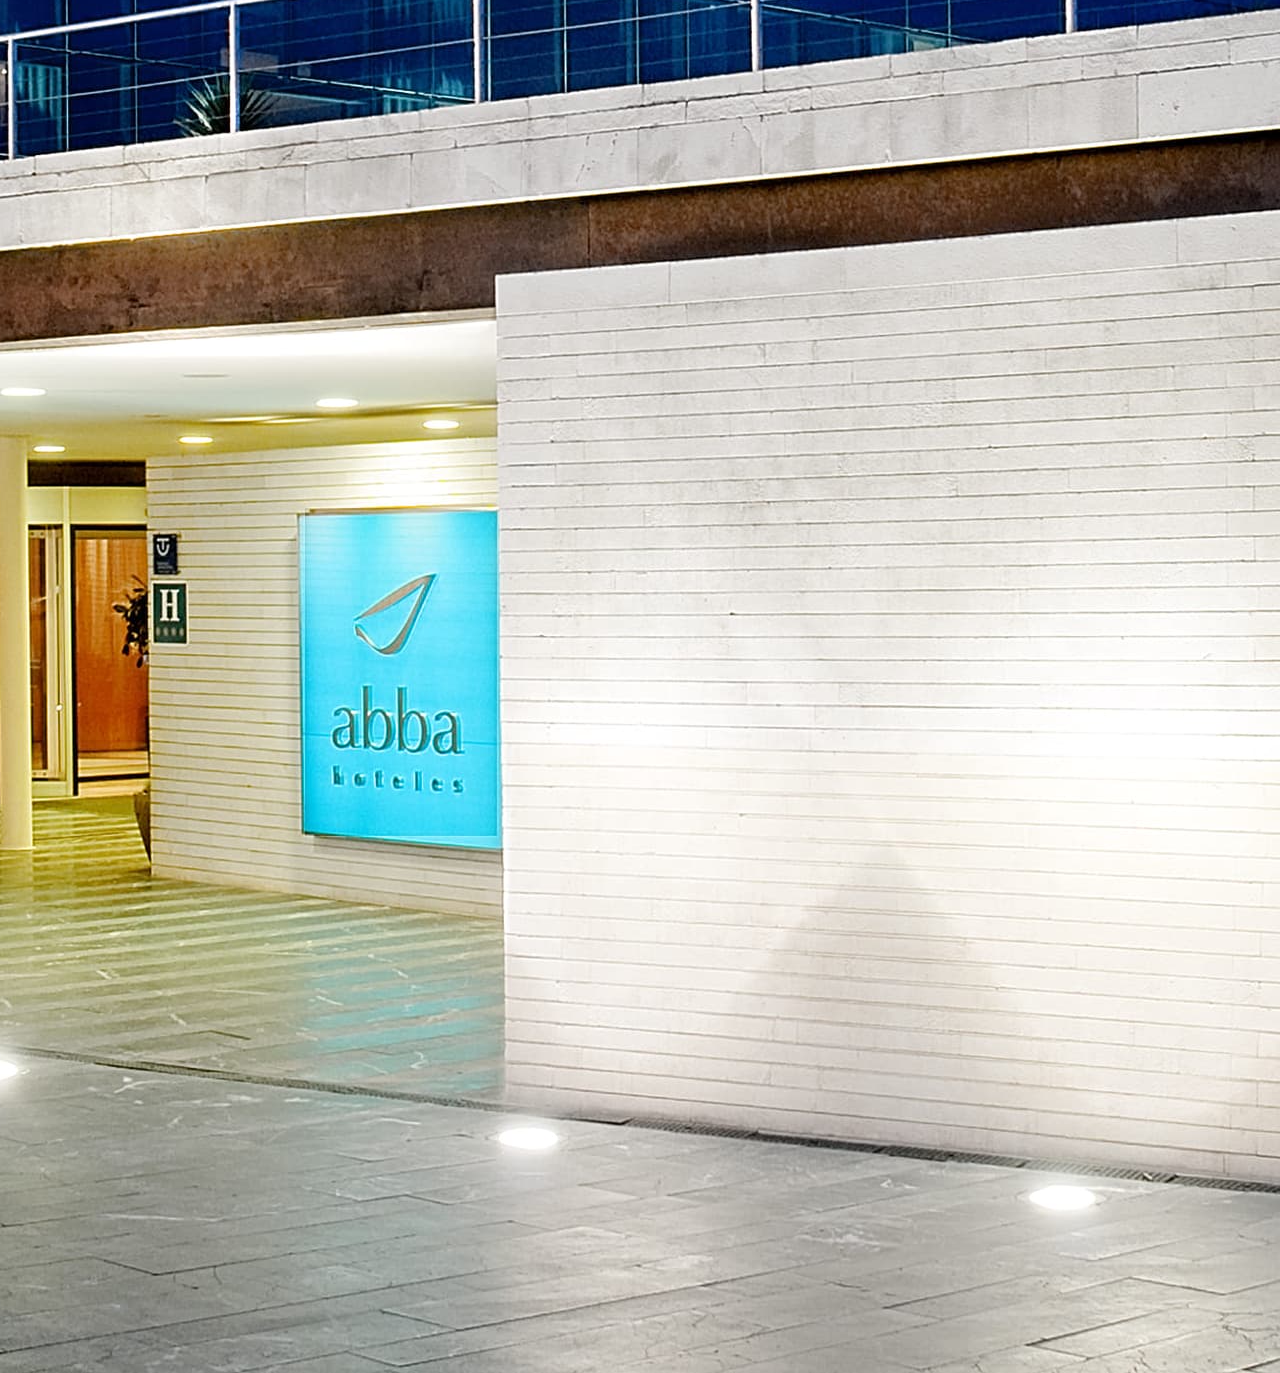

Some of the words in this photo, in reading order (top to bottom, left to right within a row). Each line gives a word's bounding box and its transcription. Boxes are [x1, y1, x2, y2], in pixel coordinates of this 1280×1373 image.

[159, 589, 180, 622] H
[332, 685, 465, 754] abba
[332, 765, 464, 793] hoteles
